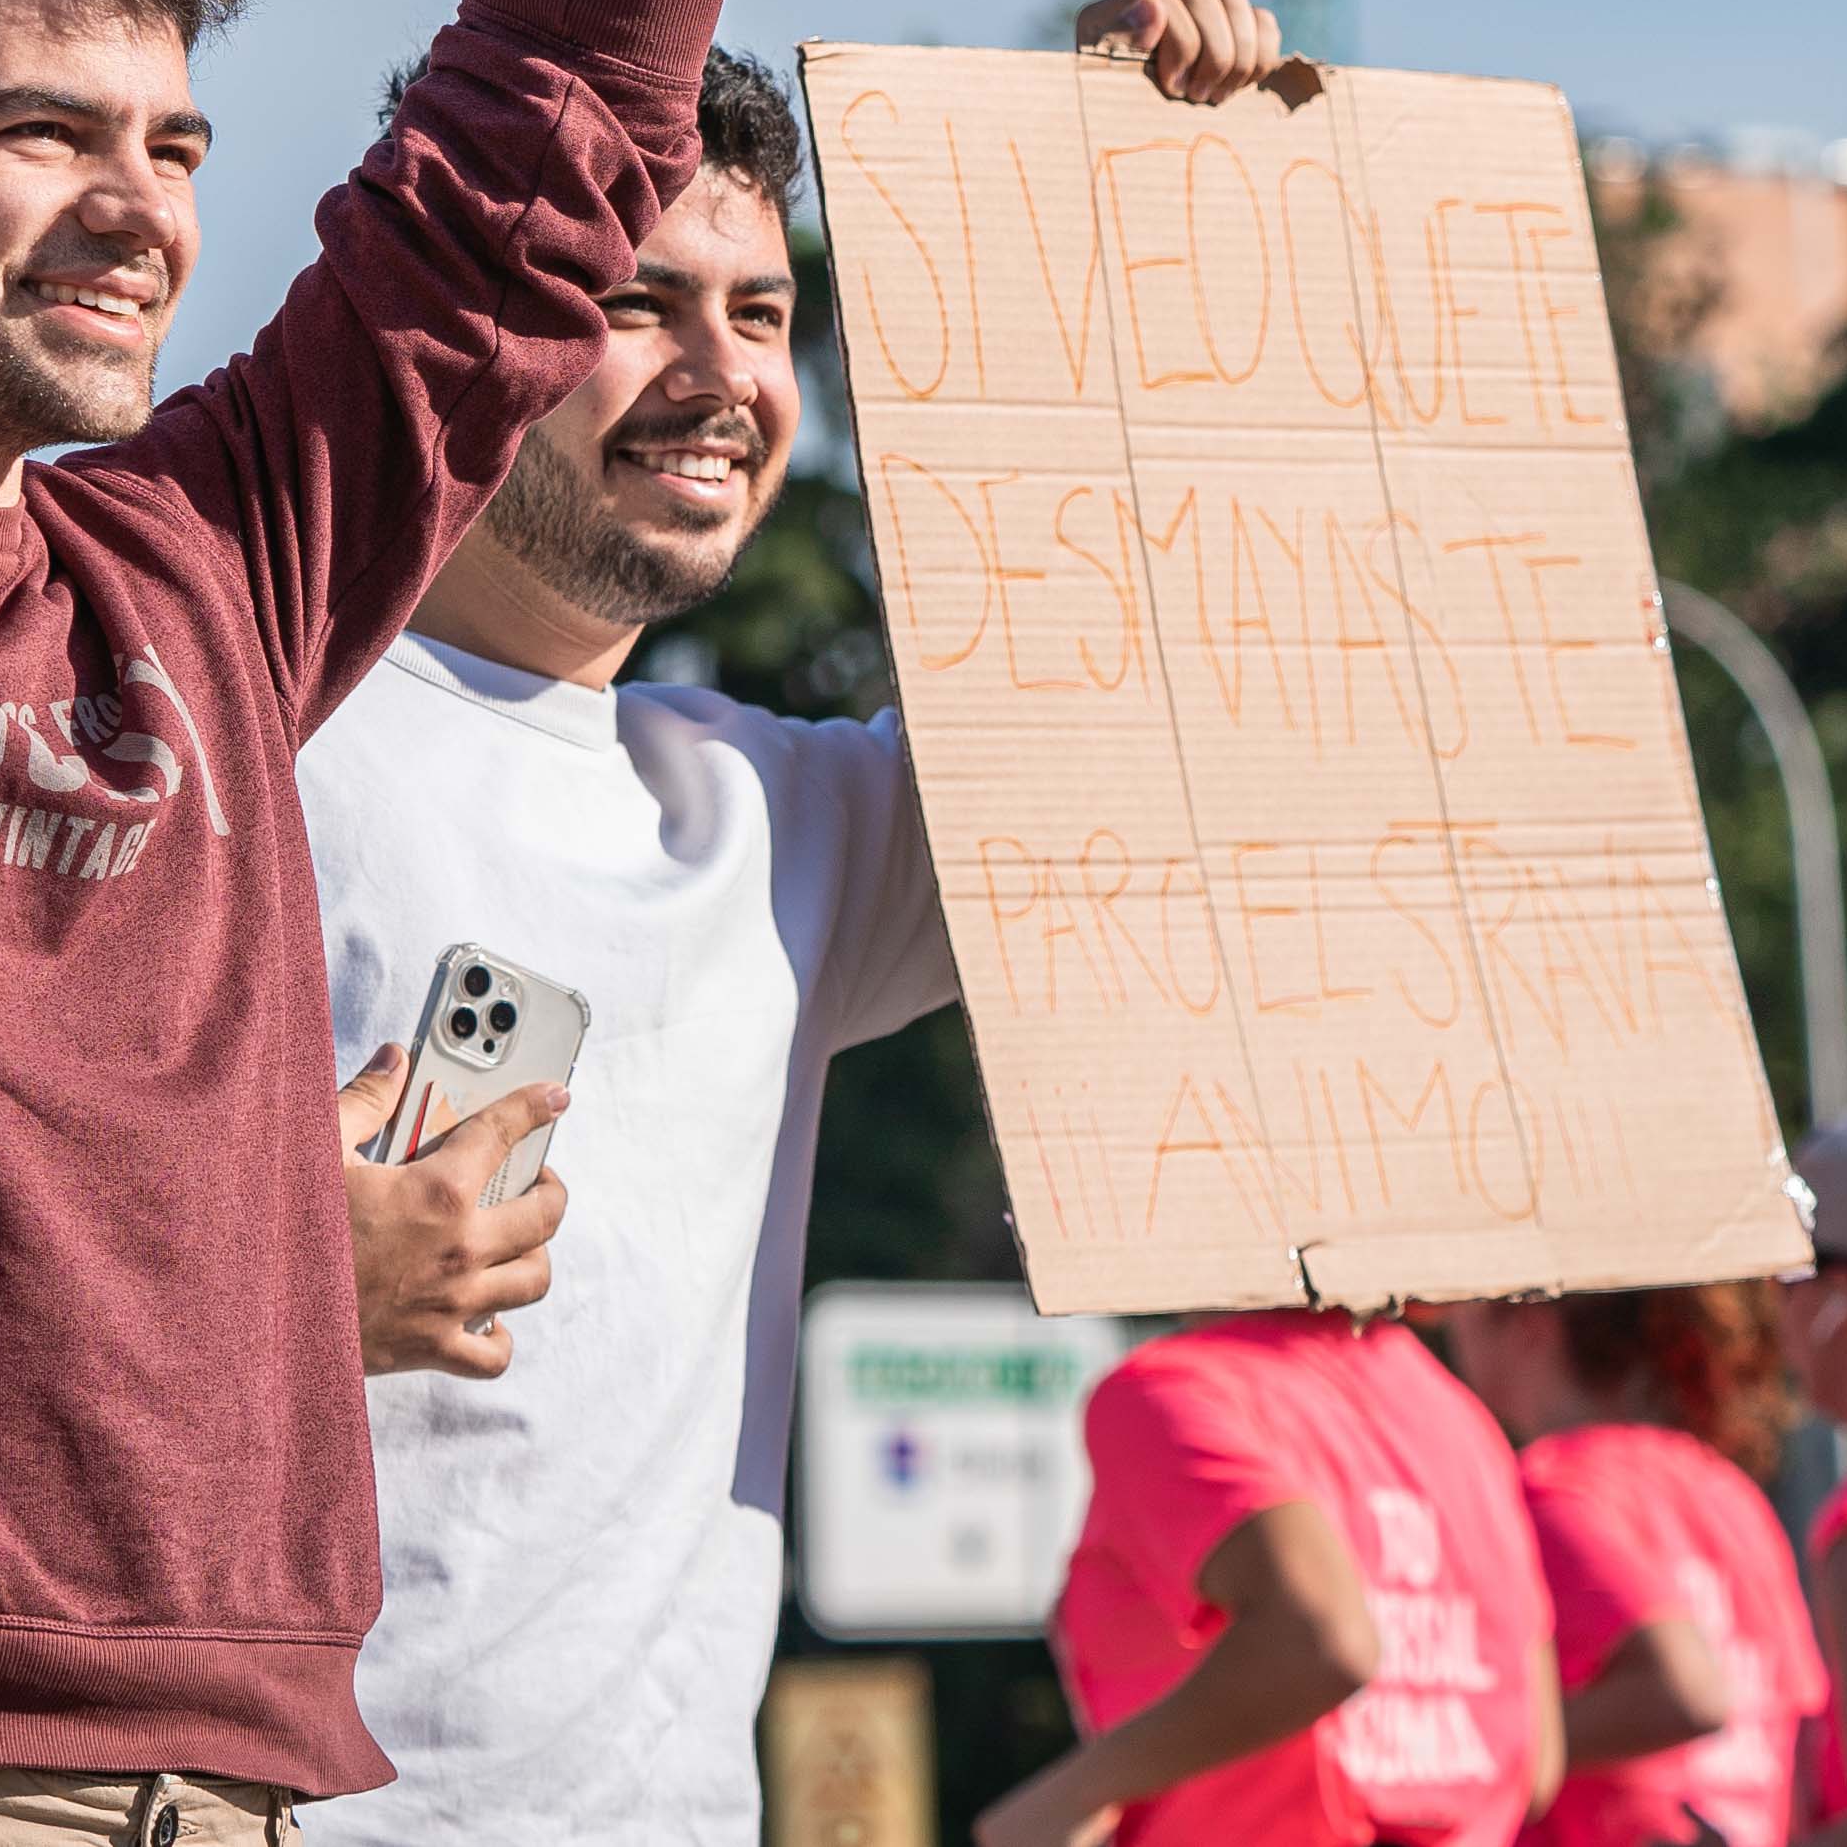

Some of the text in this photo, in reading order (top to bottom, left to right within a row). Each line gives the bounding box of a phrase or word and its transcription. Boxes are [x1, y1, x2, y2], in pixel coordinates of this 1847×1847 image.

[841, 91, 984, 399] SI
[1011, 132, 1270, 396] VEO
[978, 818, 1746, 1064] PARO EL STRAVA
